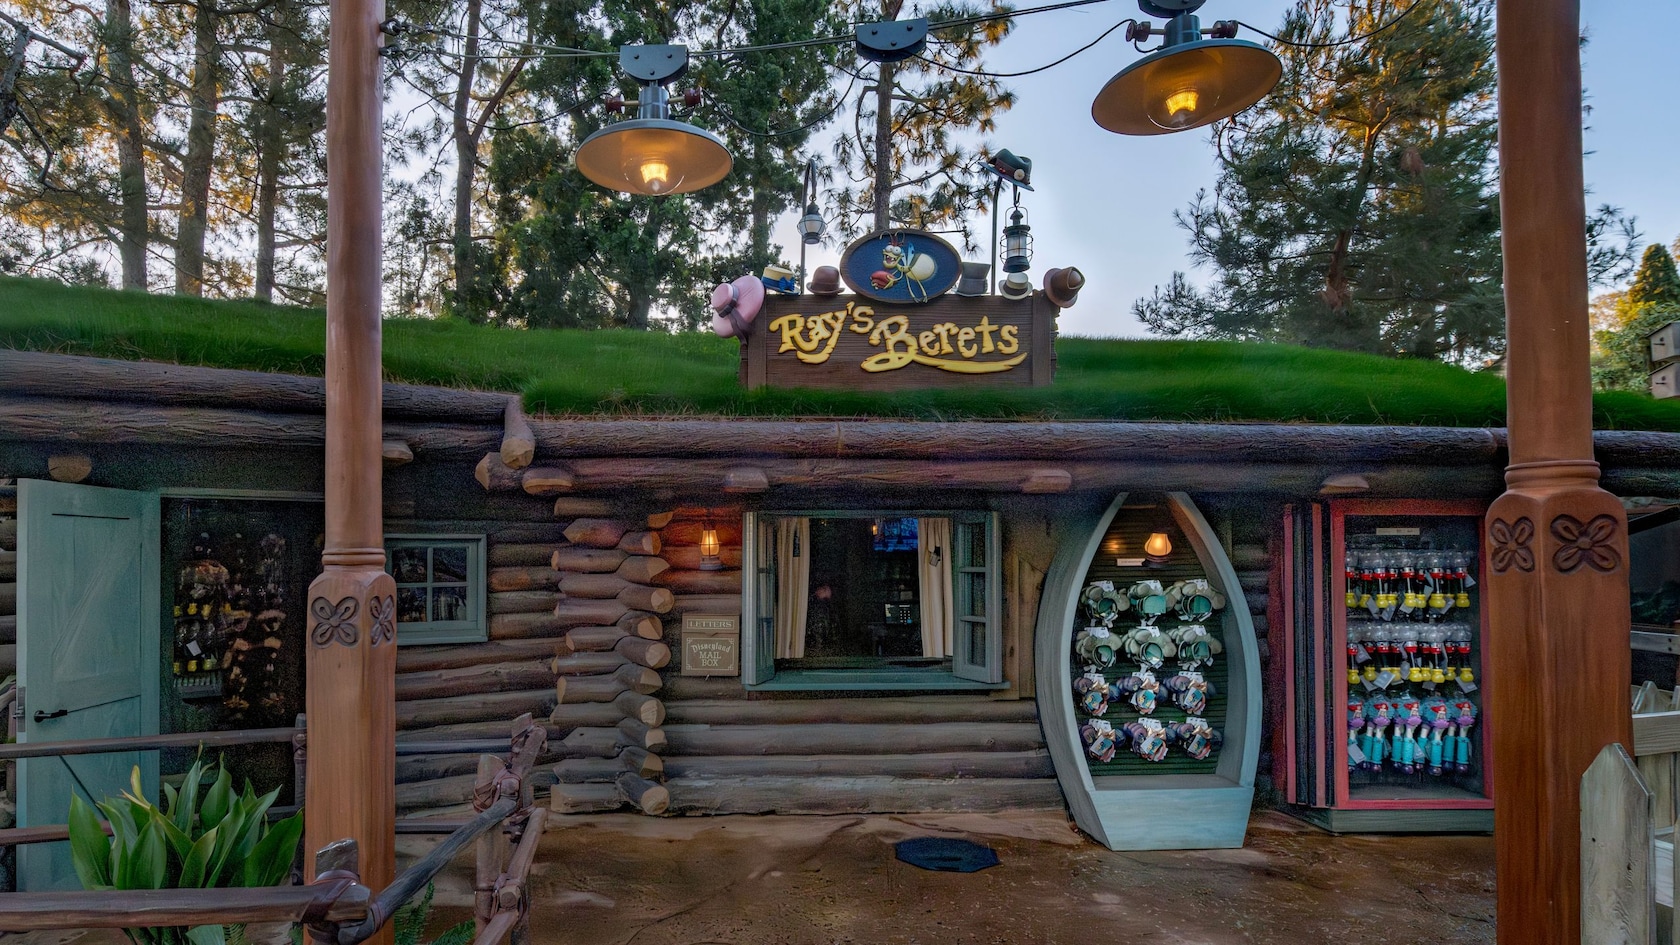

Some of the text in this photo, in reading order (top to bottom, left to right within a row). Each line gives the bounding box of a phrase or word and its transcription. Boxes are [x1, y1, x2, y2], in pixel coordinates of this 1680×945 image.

[769, 301, 1028, 373] Ray's Berets
[691, 642, 732, 653] Disneyland
[702, 659, 718, 667] BOX
